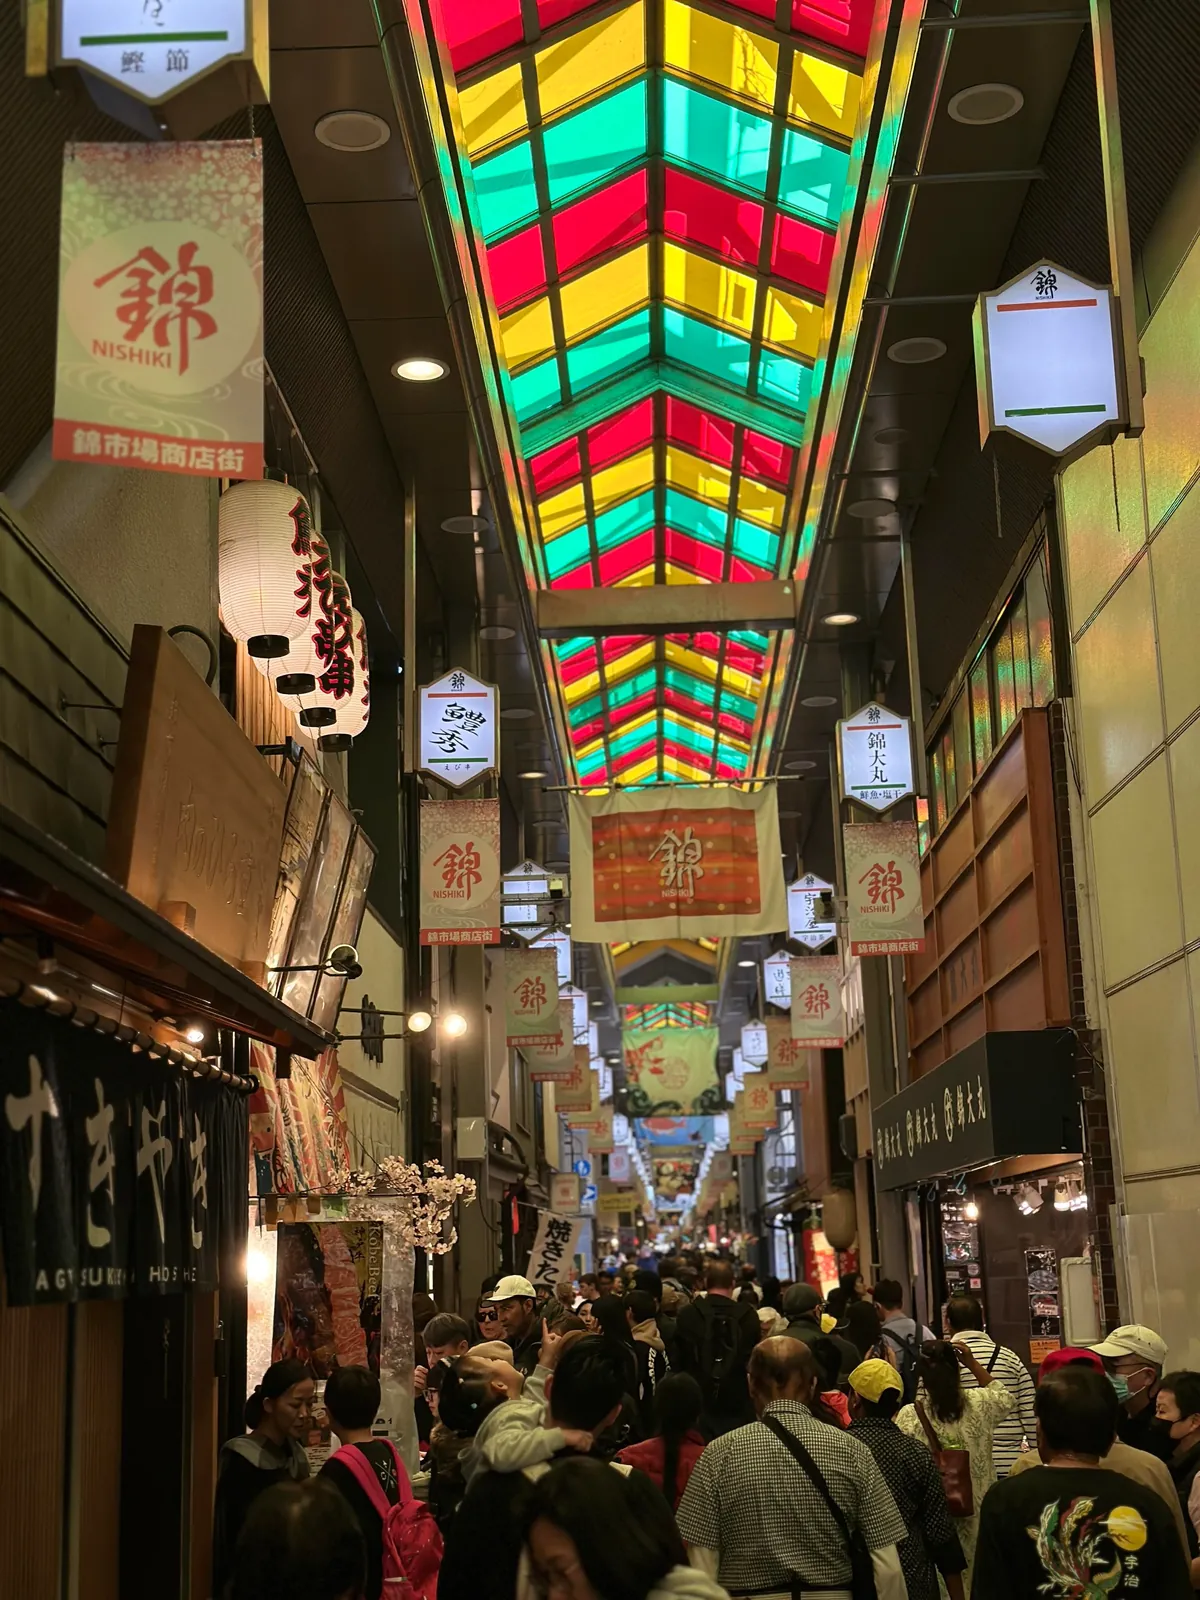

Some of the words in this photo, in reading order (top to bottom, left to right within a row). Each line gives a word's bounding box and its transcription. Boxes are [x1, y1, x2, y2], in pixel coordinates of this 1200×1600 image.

[121, 49, 190, 74] 鰹節
[1030, 269, 1058, 299] 錦
[93, 241, 218, 376] 錦
[91, 339, 172, 370] NISHIKI
[72, 427, 245, 473] 錦市場商店街
[865, 707, 881, 724] 錦
[867, 731, 889, 784] 錦大丸
[433, 841, 483, 901] 錦
[648, 826, 704, 899] 錦
[433, 890, 465, 898] NISHIKI
[858, 860, 905, 914] 錦
[860, 905, 890, 913] NISHIKI
[427, 930, 494, 943] 錦市場商店街
[857, 941, 919, 954] 錦市場商店街
[514, 976, 548, 1016] 錦
[799, 983, 831, 1020] 錦
[368, 1226, 381, 1264] Kobe
[368, 1266, 381, 1299] Beef
